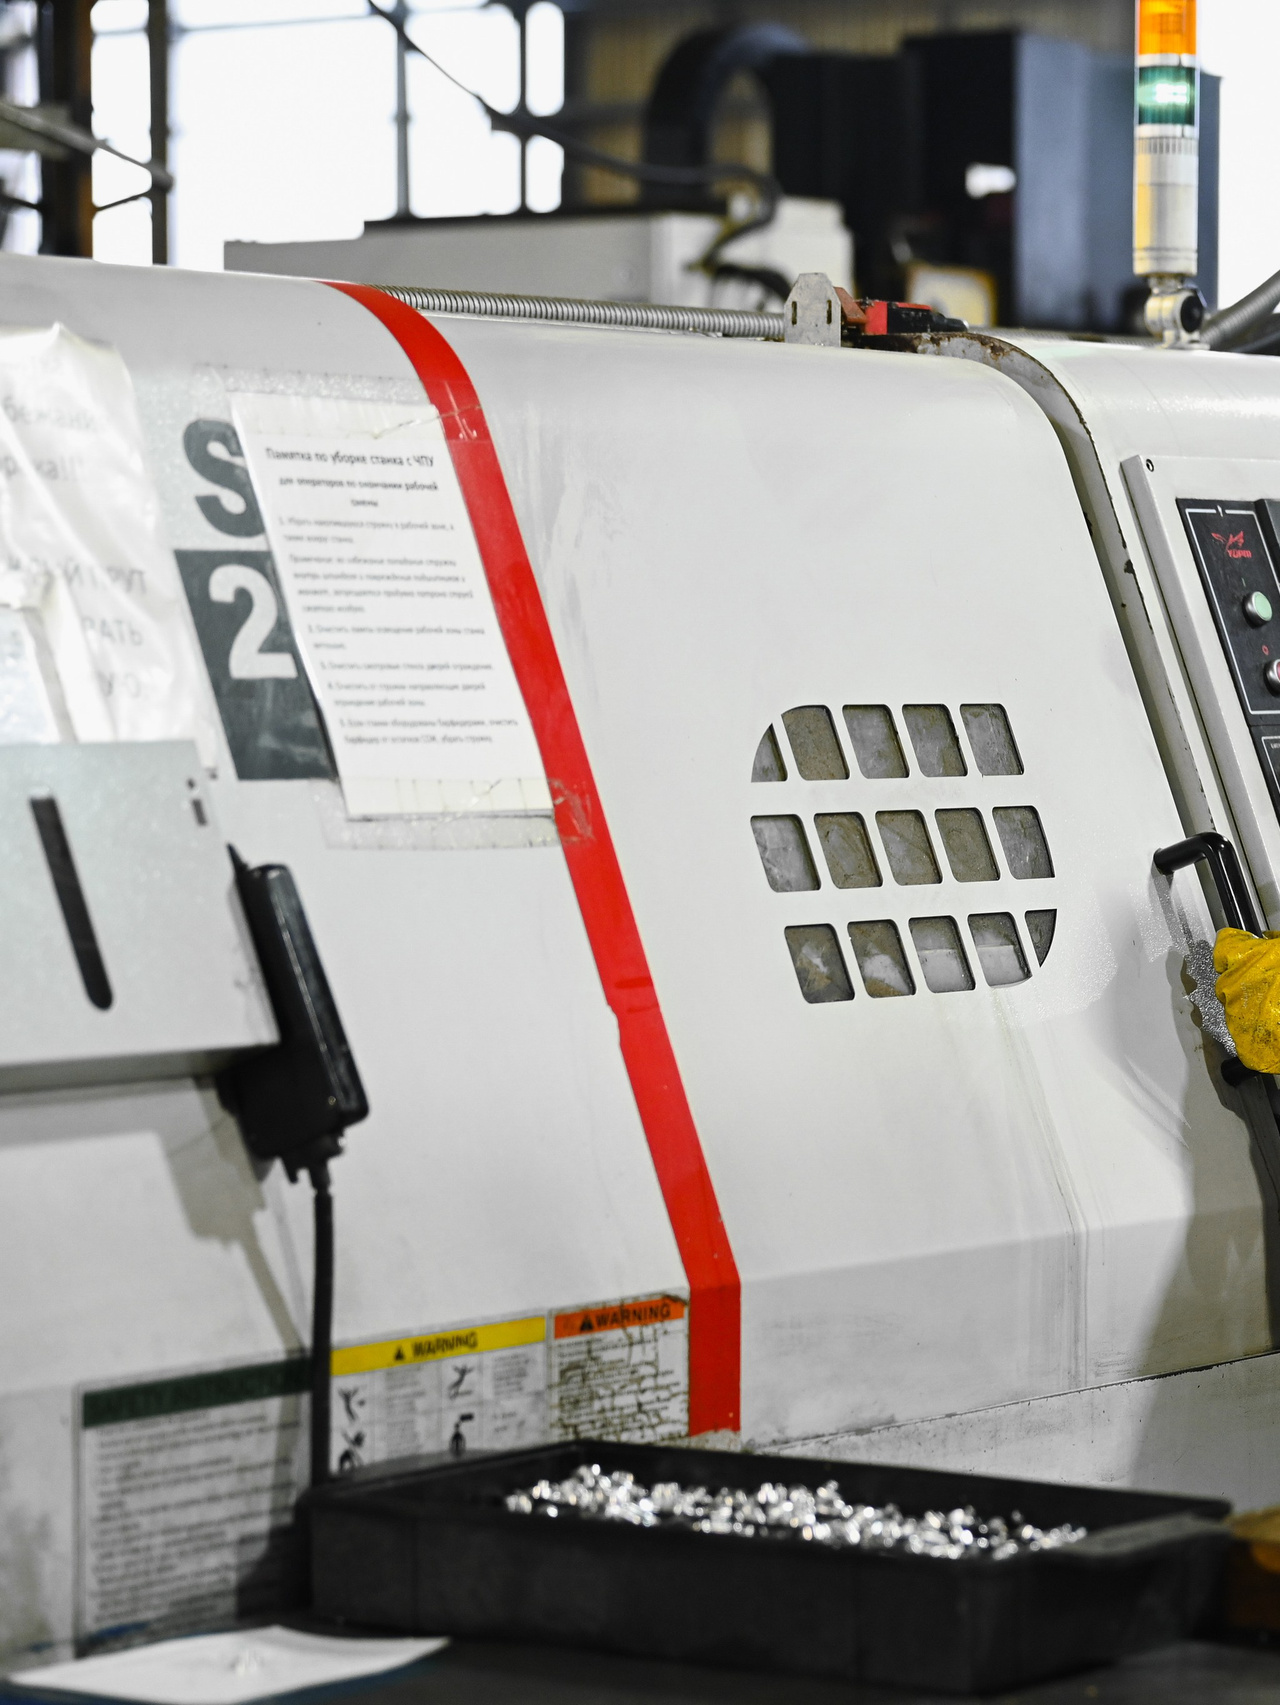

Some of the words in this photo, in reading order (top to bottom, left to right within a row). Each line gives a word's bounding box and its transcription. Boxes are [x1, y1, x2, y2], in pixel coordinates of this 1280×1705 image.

[265, 447, 312, 462] Памятка
[314, 451, 328, 463] по
[330, 451, 367, 465] уборке
[370, 455, 404, 467] станка
[412, 455, 434, 468] ЧПУ
[183, 419, 265, 538] S
[208, 564, 298, 679] 2
[596, 1304, 671, 1328] WARNING
[412, 1332, 478, 1358] WARNING
